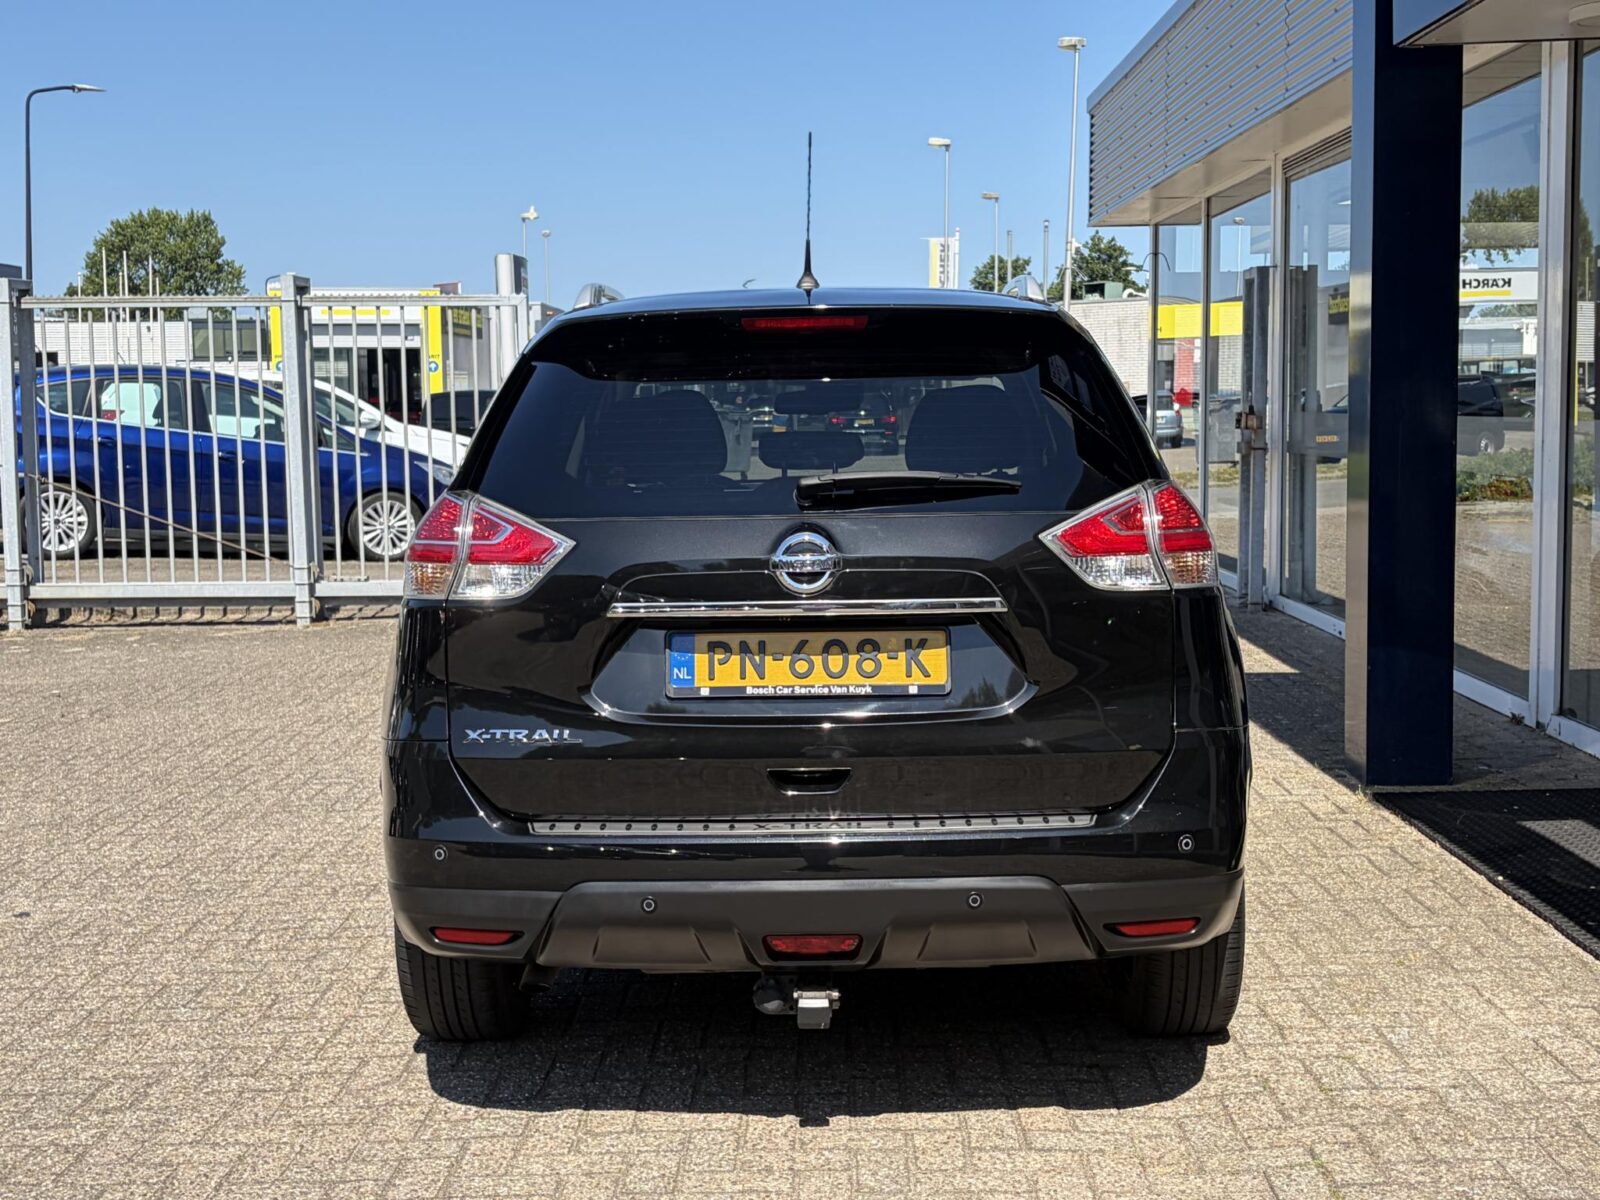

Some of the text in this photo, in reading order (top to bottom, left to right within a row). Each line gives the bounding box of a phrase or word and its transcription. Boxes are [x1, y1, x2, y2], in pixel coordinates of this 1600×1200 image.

[707, 638, 931, 680] PN-608-K
[673, 667, 692, 679] NL
[746, 684, 872, 695] Bosch Car Service Van Kuyk
[462, 728, 583, 744] X-TRAIL
[753, 821, 873, 831] X-TRAIL
